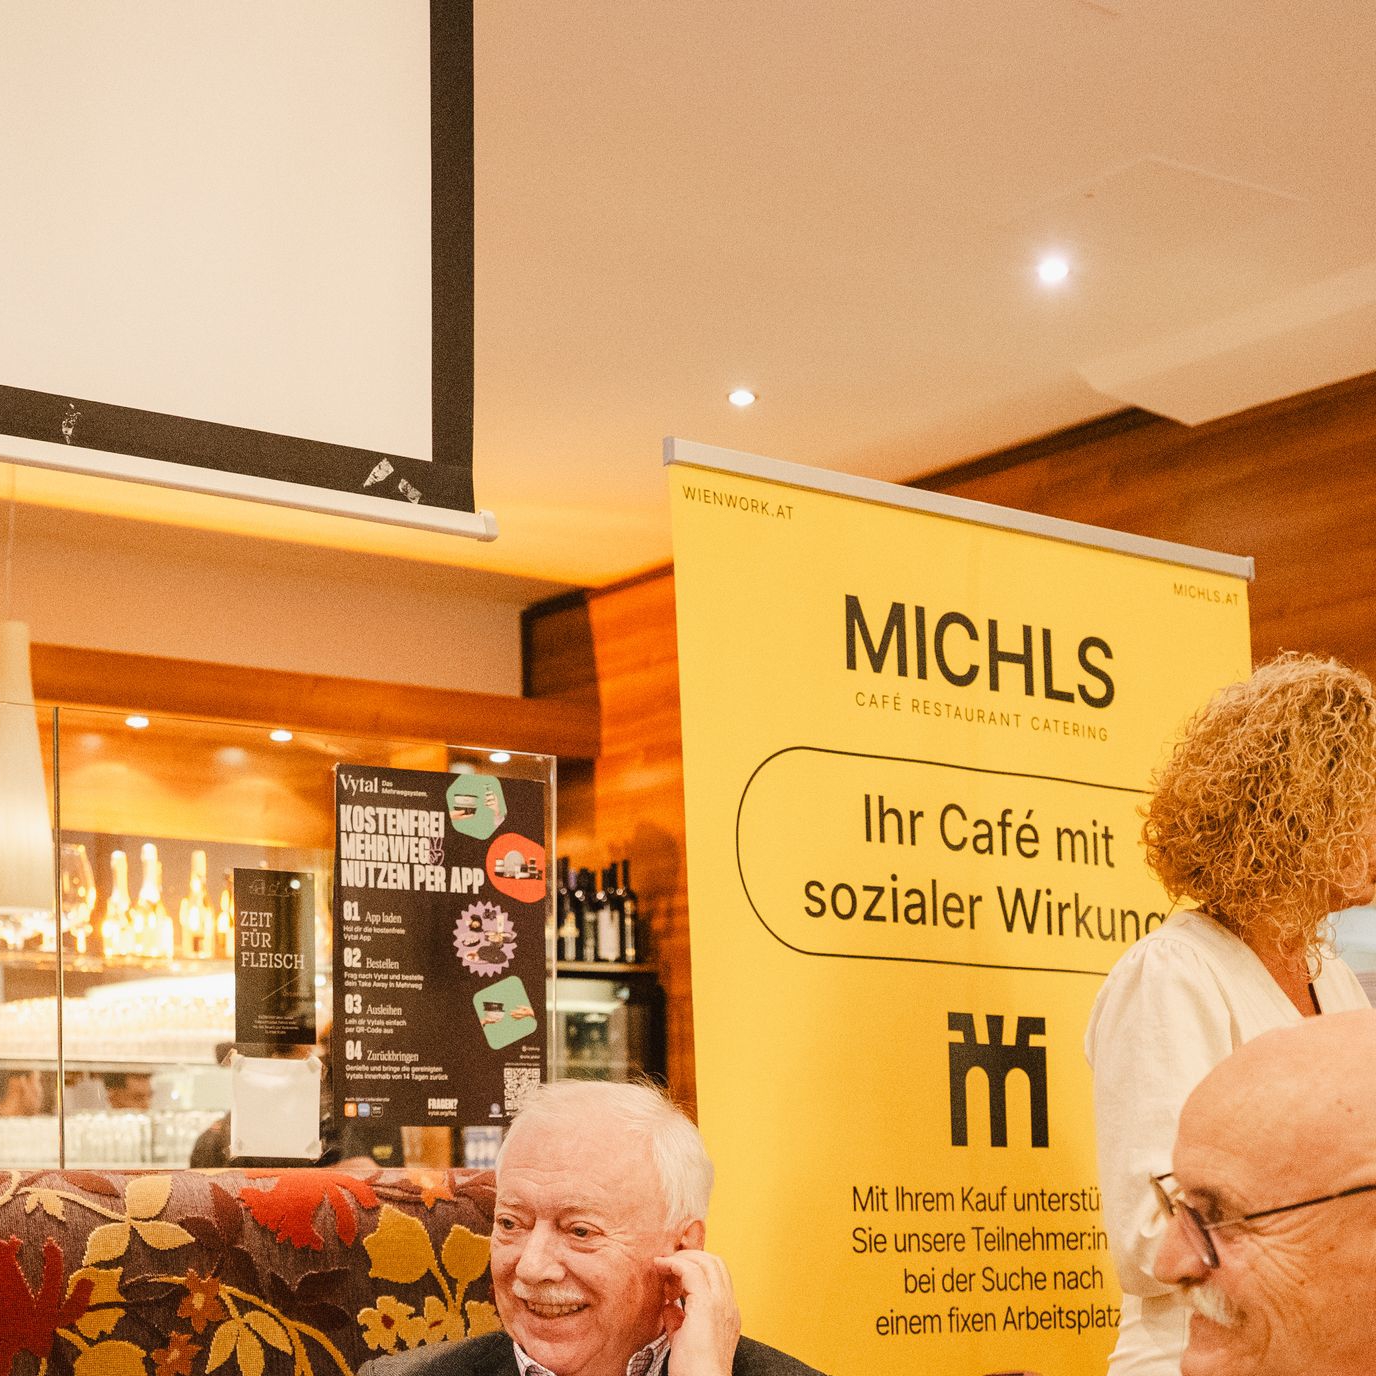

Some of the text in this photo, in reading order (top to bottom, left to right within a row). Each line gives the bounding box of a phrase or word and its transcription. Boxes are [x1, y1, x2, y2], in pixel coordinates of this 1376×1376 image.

[682, 485, 794, 520] WIENWORK.AT
[1173, 583, 1239, 606] MICHLS.AT
[843, 593, 1115, 709] MICHLS
[855, 691, 1109, 742] CAFÉ RESTAURANT CATERING
[339, 774, 379, 797] Vytal
[339, 804, 445, 838] KOSTENFREI
[864, 793, 1115, 868] Ihr Café mit
[340, 832, 431, 865] MEHRWEG
[340, 859, 485, 895] NUTZEN PER APP
[343, 900, 402, 925] 01 App laden
[803, 872, 983, 931] sozialer
[239, 911, 273, 928] ZEIT
[240, 929, 272, 948] FÜR
[240, 951, 305, 970] FLEISCH
[343, 947, 400, 969] 02 Bestellen
[344, 993, 403, 1016] 03 Ausleihen
[345, 1039, 419, 1064] 04 Zurückbringen
[852, 1185, 1103, 1212] Mit Ihrem Kauf unterstü
[852, 1225, 1108, 1253] Sie unsere Teilnehmer:in
[904, 1264, 1104, 1293] bei der Suche nach
[876, 1303, 1121, 1336] einem fixen Arbeitsplatz
